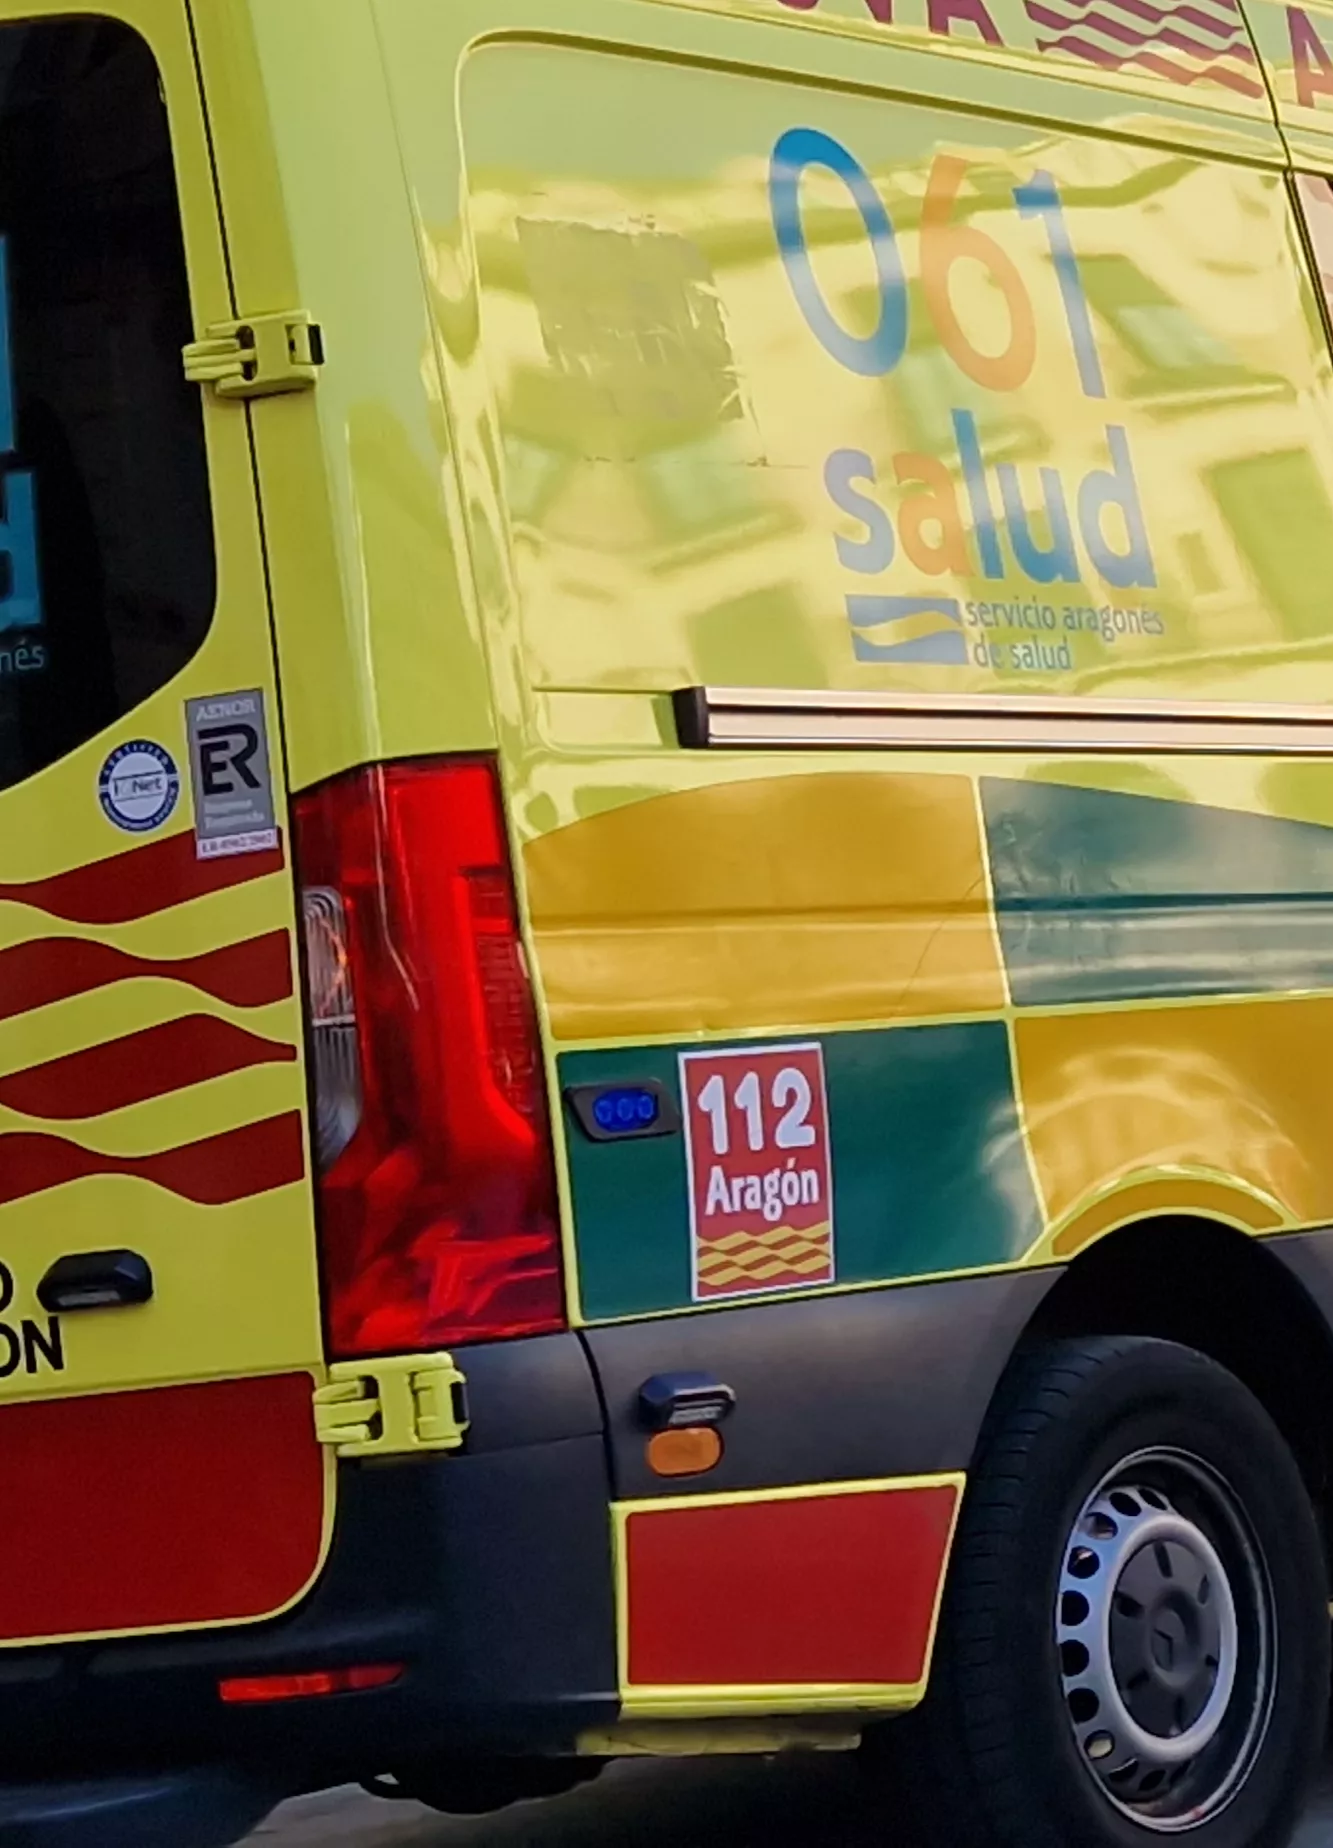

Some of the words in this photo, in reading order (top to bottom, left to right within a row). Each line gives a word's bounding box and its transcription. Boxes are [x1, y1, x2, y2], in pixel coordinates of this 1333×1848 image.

[769, 127, 1107, 399] 061
[824, 407, 1157, 589] salud
[964, 597, 1057, 630] servicio
[1063, 602, 1165, 642] aragonés
[973, 633, 1000, 668] de
[1012, 634, 1073, 670] salud
[697, 1067, 816, 1155] 112
[705, 1157, 820, 1222] Aragón
